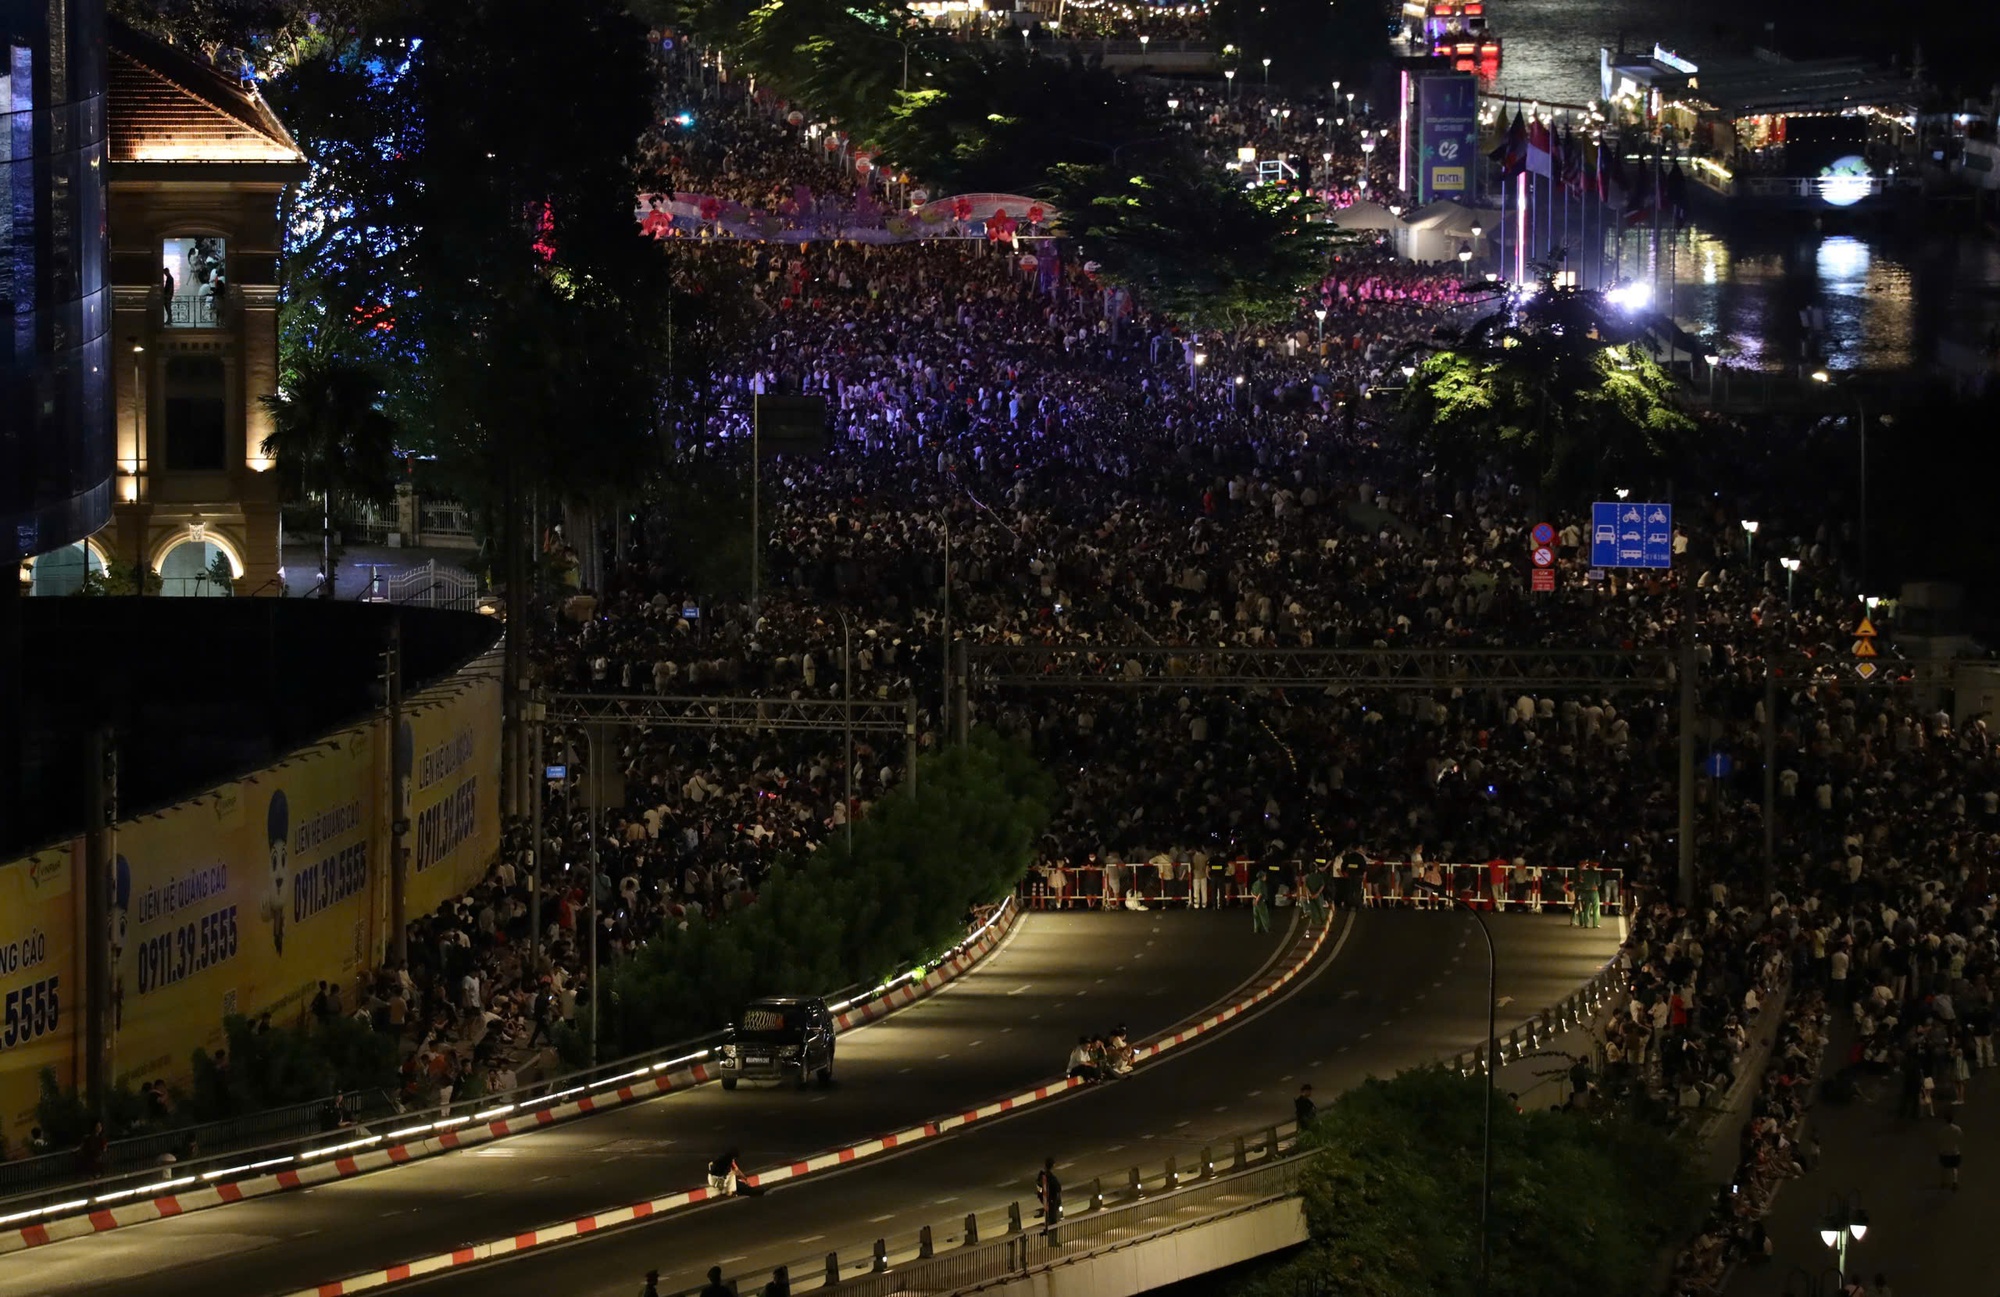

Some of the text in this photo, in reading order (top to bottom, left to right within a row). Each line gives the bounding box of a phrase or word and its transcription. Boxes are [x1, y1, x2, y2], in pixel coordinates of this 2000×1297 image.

[1439, 142, 1459, 160] C2
[295, 818, 310, 855] LIÊN
[312, 811, 321, 850] HỆ
[346, 795, 360, 829] CÁO
[417, 776, 476, 872] 0911.39.5555
[138, 858, 227, 923] LIÊN HỆ QUẢNG CÁO
[294, 840, 366, 923] 0911.39.5555
[22, 927, 45, 967] CÁO
[138, 905, 238, 994] 0911.39.5555
